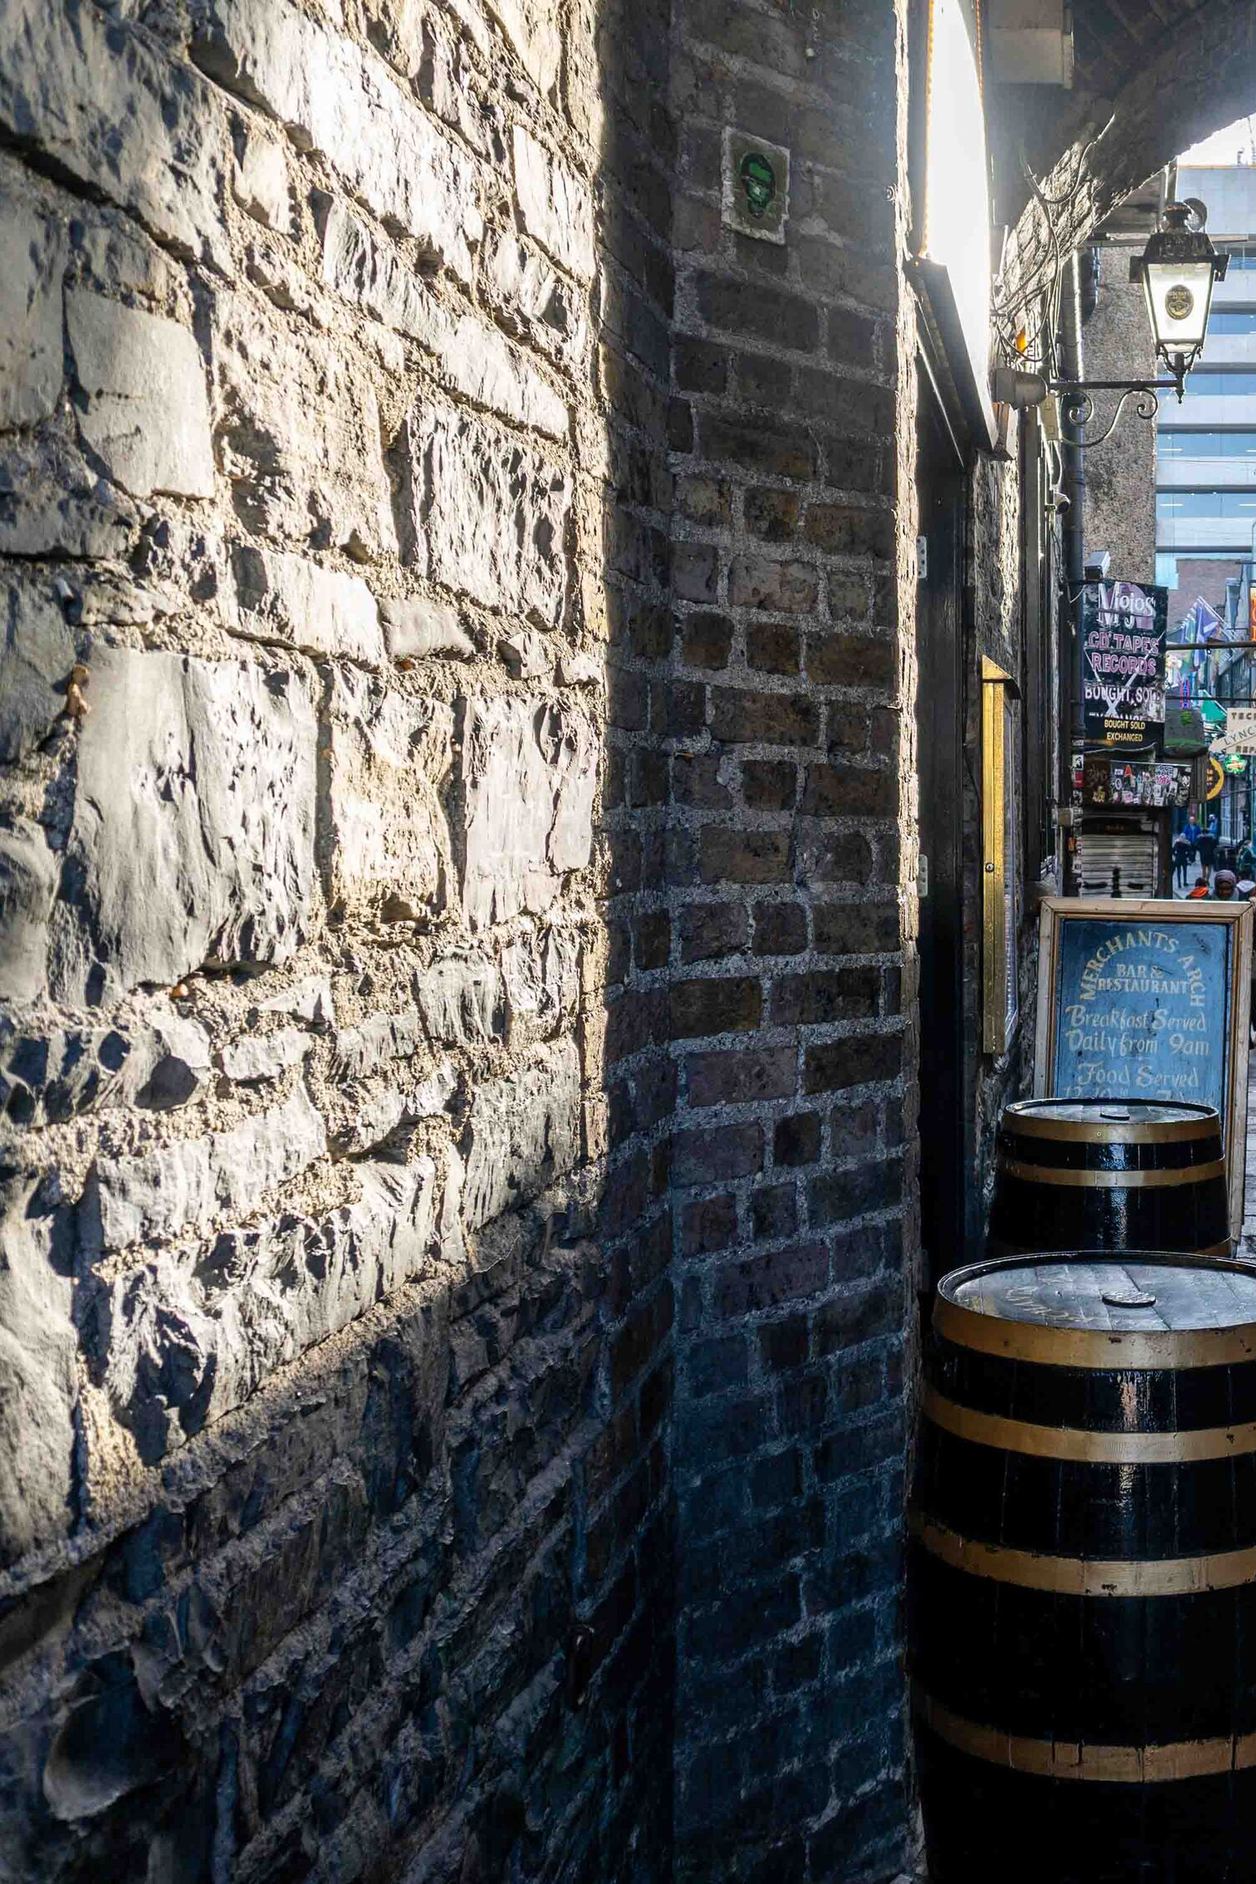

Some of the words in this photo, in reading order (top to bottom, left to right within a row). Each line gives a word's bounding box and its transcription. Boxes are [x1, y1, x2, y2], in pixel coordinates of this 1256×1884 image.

[1091, 652, 1157, 676] RECORDS
[1104, 719, 1129, 729] BOUGHT
[1130, 721, 1146, 730] SOLD
[1106, 732, 1143, 742] EXCHANGED
[1080, 929, 1179, 1000] MERCHANTS
[1177, 954, 1206, 1008] ARCH
[1116, 963, 1148, 979] BAR
[1097, 977, 1192, 994] RESTAURANT
[1065, 1004, 1151, 1030] Breakfast
[1152, 1008, 1207, 1032] Served
[1065, 1027, 1117, 1058] Daily
[1119, 1031, 1159, 1057] from
[1168, 1033, 1210, 1057] 9am
[1076, 1061, 1131, 1086] Food
[1136, 1065, 1200, 1088] Served
